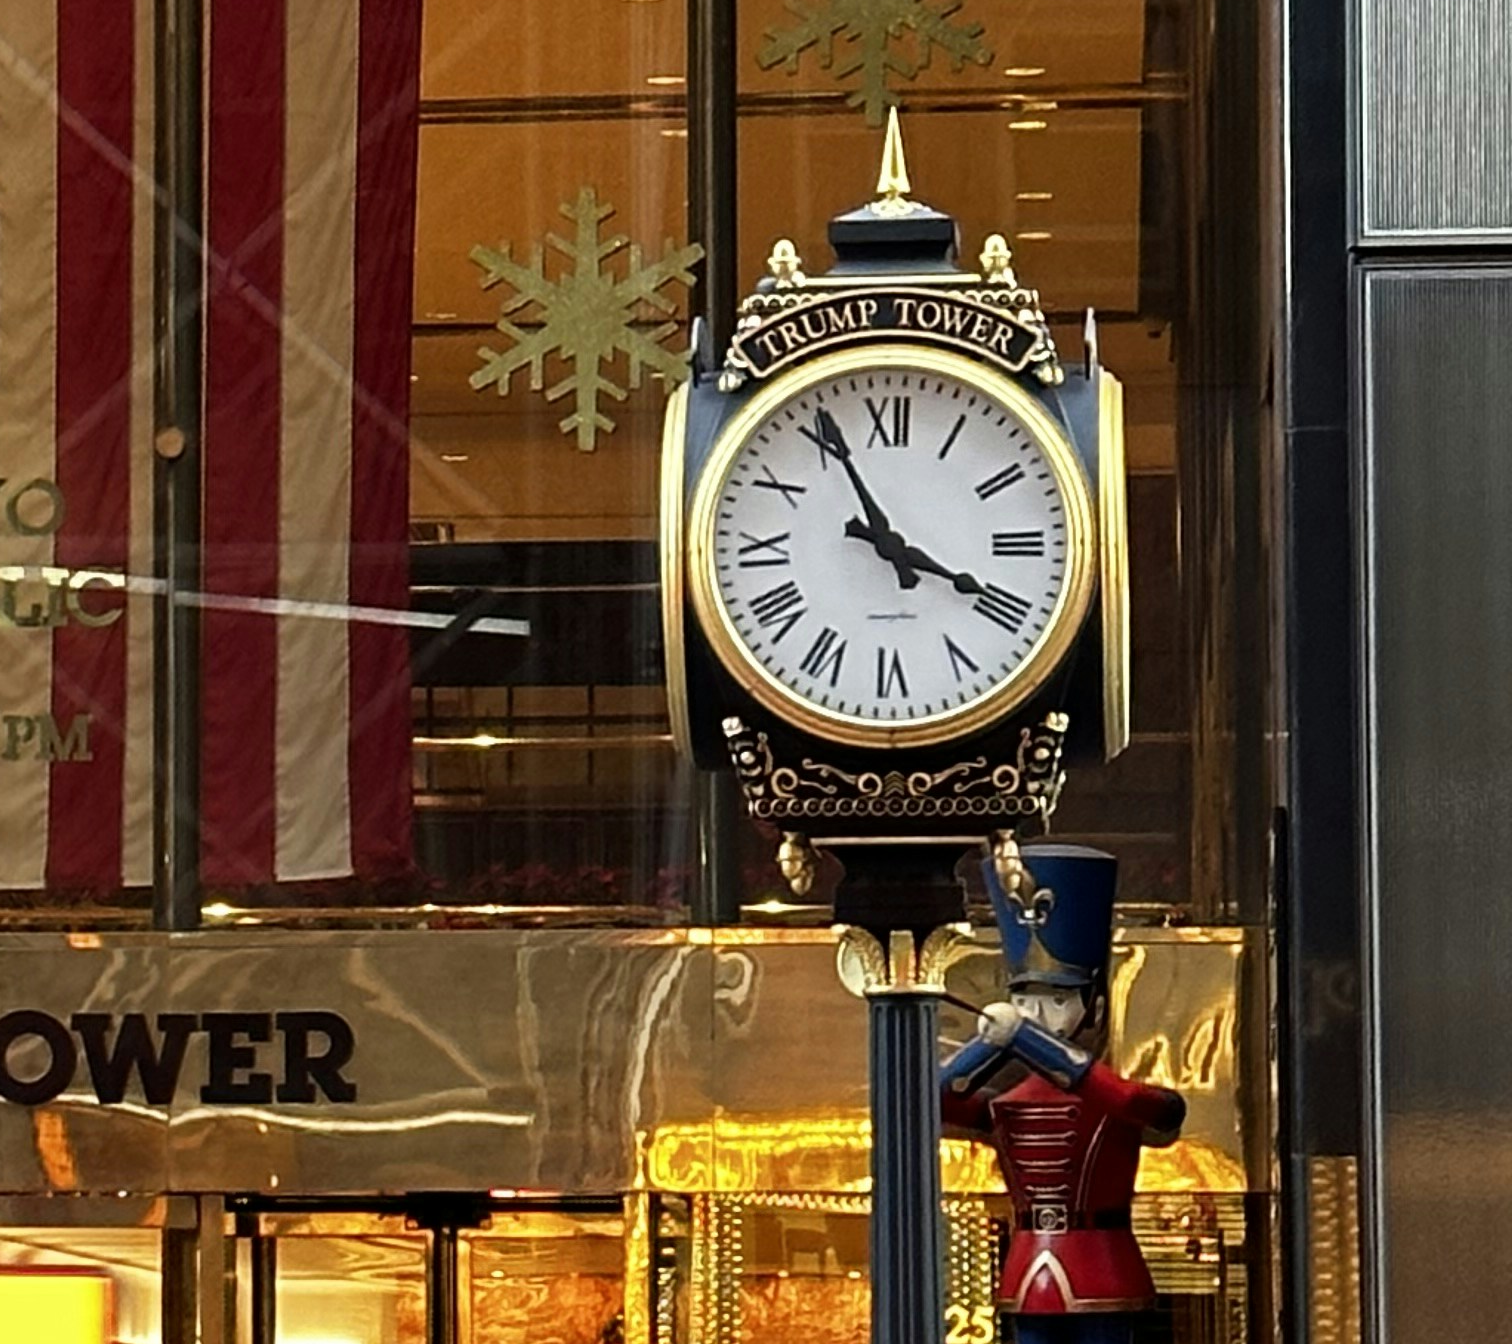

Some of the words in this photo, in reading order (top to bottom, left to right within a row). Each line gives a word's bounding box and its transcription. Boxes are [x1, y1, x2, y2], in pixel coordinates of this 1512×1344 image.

[755, 298, 879, 357] TRUMP
[893, 298, 1015, 355] TOWER
[865, 396, 911, 449] XII
